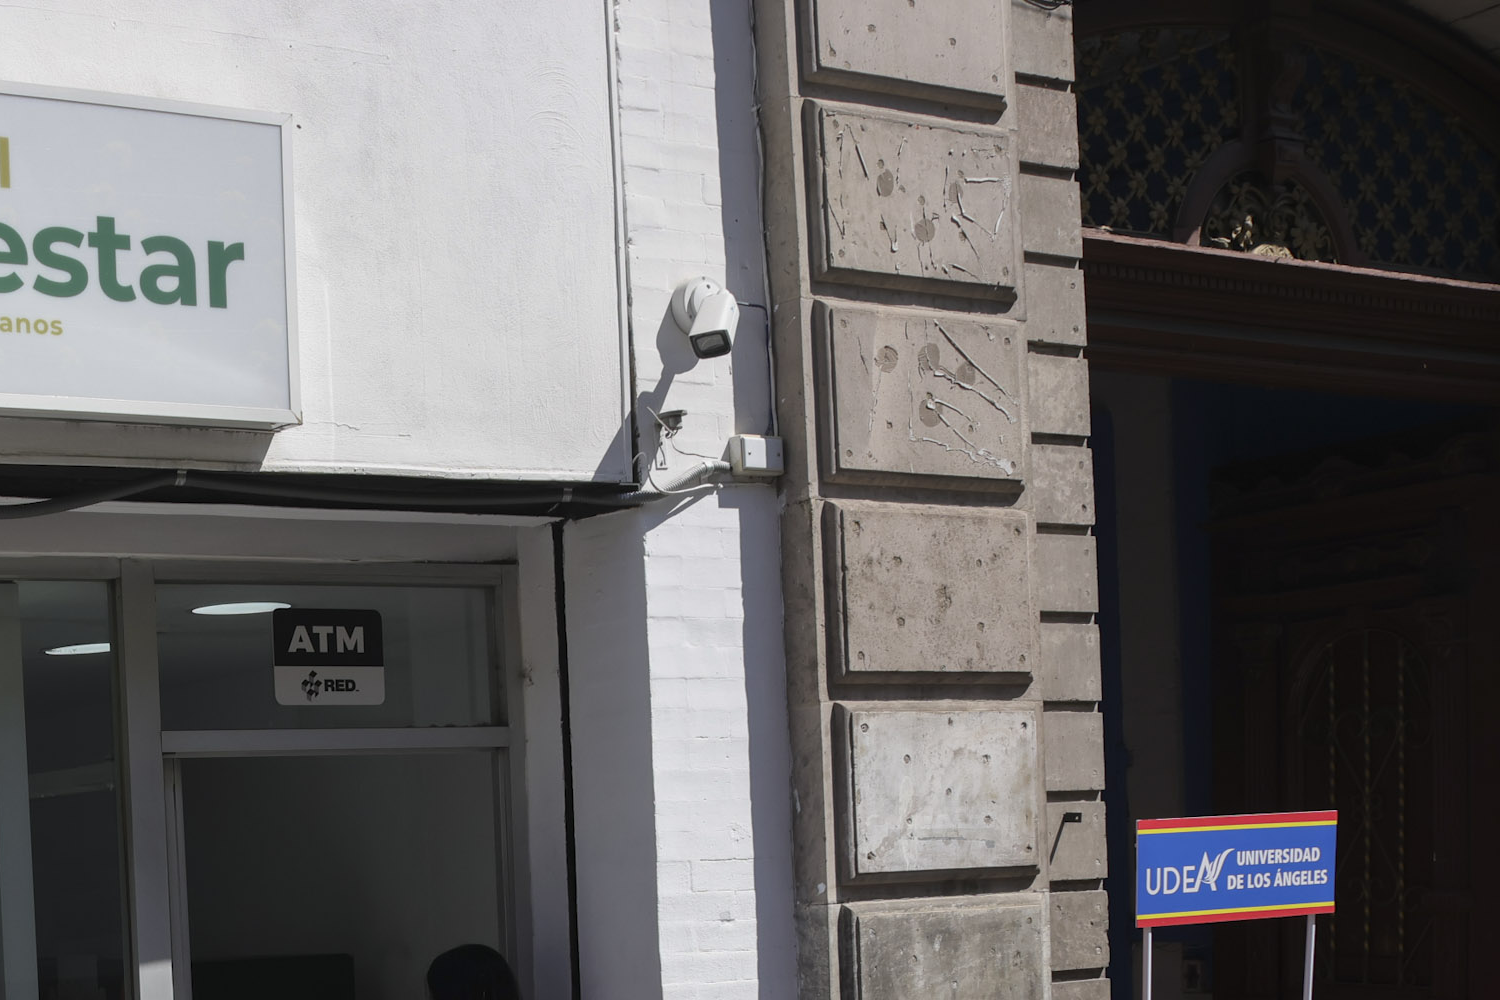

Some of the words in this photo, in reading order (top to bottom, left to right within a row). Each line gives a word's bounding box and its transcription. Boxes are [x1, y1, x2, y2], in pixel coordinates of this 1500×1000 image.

[287, 625, 365, 653] ATM
[323, 679, 357, 692] RED
[1236, 847, 1321, 866] UNIVERSIDAD
[1227, 874, 1245, 890] DE
[1247, 872, 1271, 888] LOS
[1274, 868, 1328, 887] ÁNGELES
